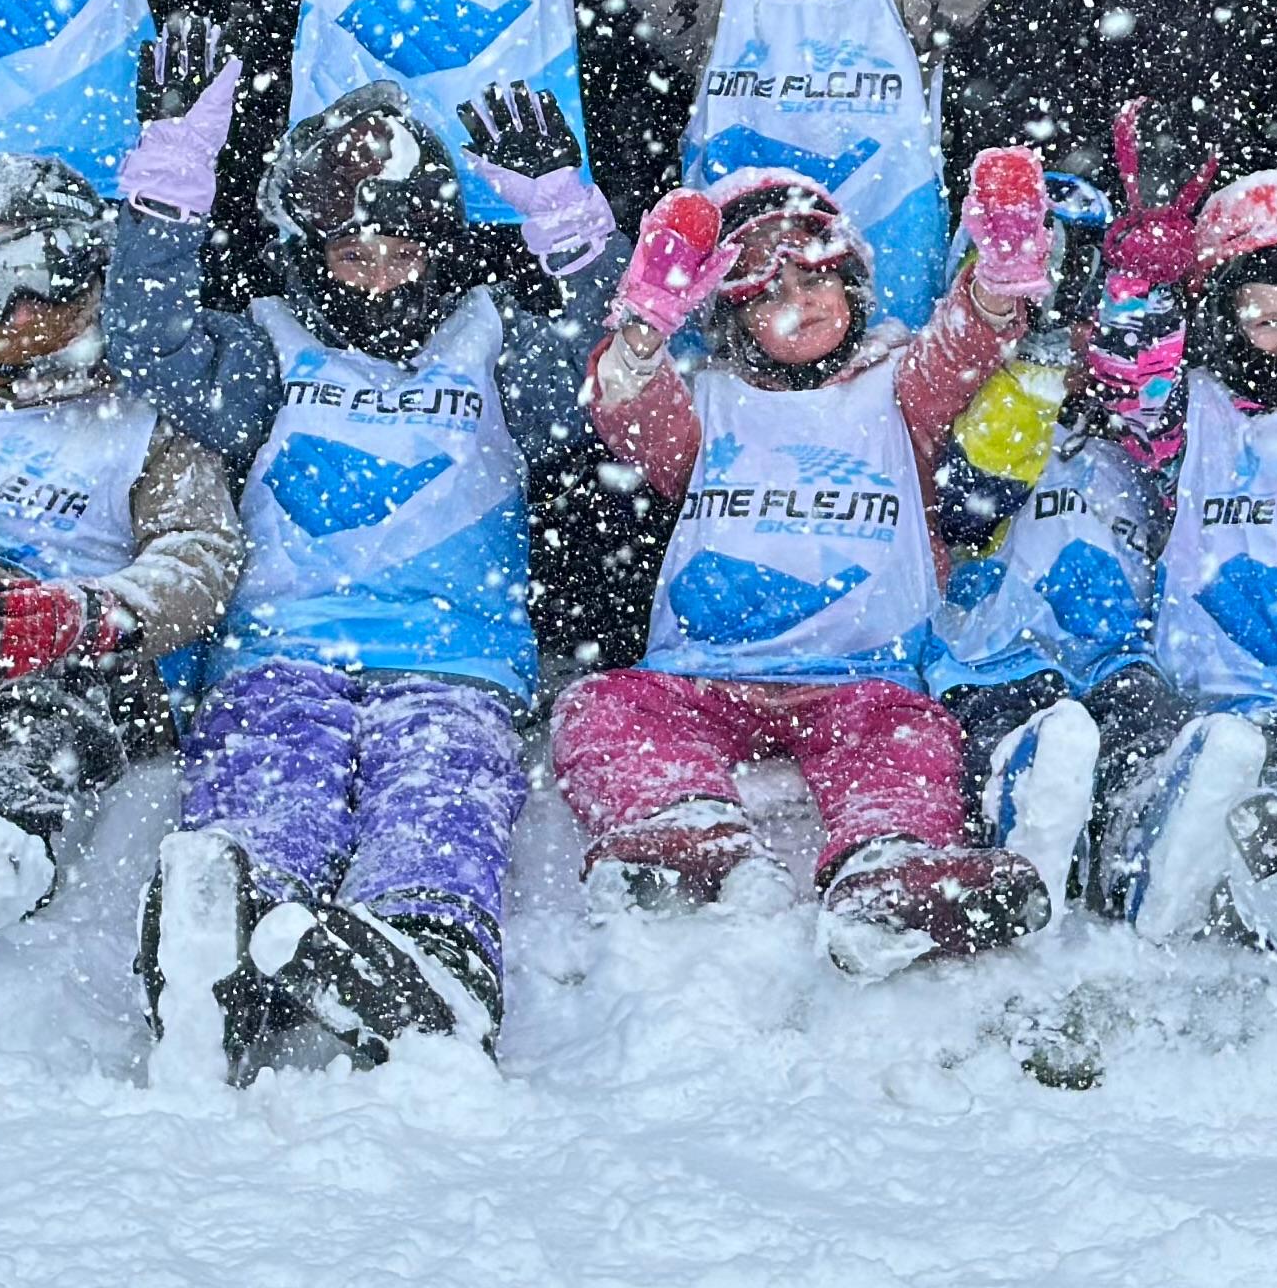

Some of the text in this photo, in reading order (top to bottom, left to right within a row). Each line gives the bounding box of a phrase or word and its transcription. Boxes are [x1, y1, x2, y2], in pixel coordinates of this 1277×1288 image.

[706, 70, 777, 98] DIME
[776, 100, 824, 113] SKI
[350, 388, 484, 420] FLEJTA
[345, 412, 397, 426] SKI
[759, 489, 901, 527] FLEJTA
[1202, 495, 1276, 526] DIME
[754, 519, 896, 543] SKI CLUB
